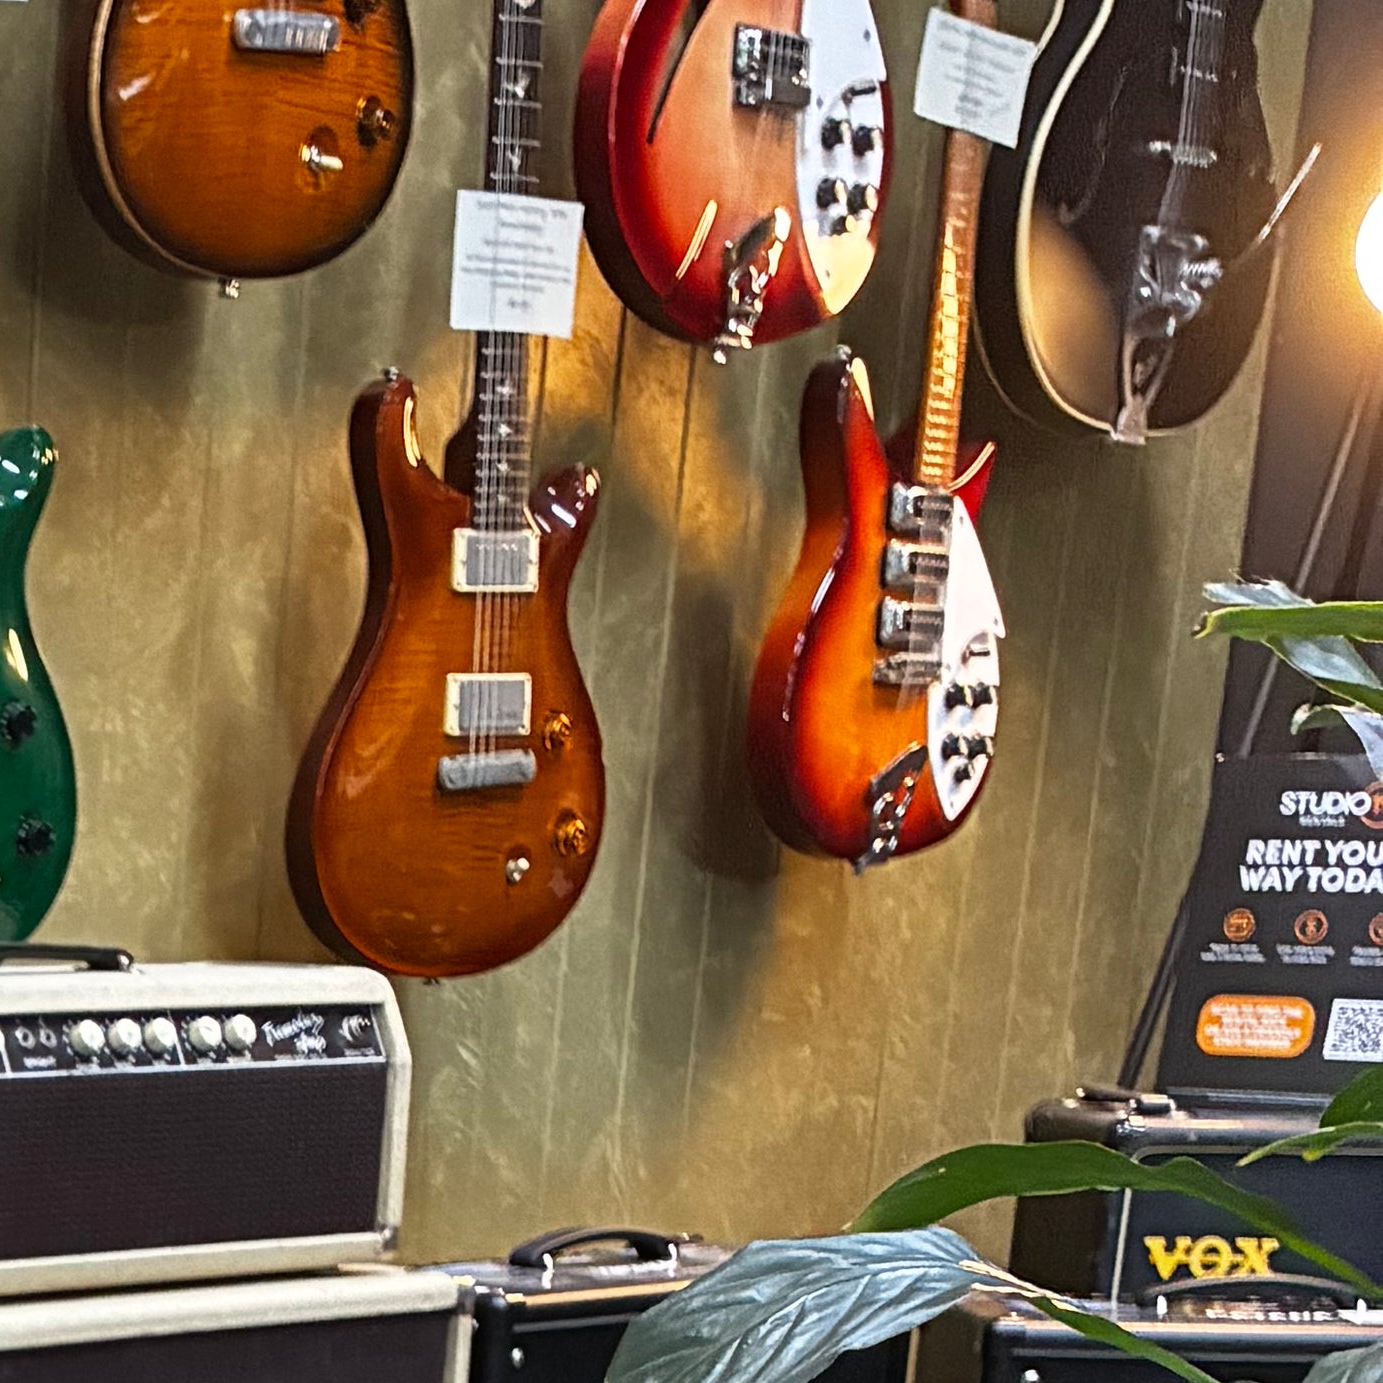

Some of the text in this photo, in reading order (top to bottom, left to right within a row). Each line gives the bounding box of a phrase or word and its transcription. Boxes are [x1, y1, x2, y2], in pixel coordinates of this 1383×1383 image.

[1279, 791, 1372, 817] STUDIO
[1245, 838, 1322, 866] RENT
[1239, 864, 1304, 893] WAY
[1142, 1234, 1280, 1280] VOX
